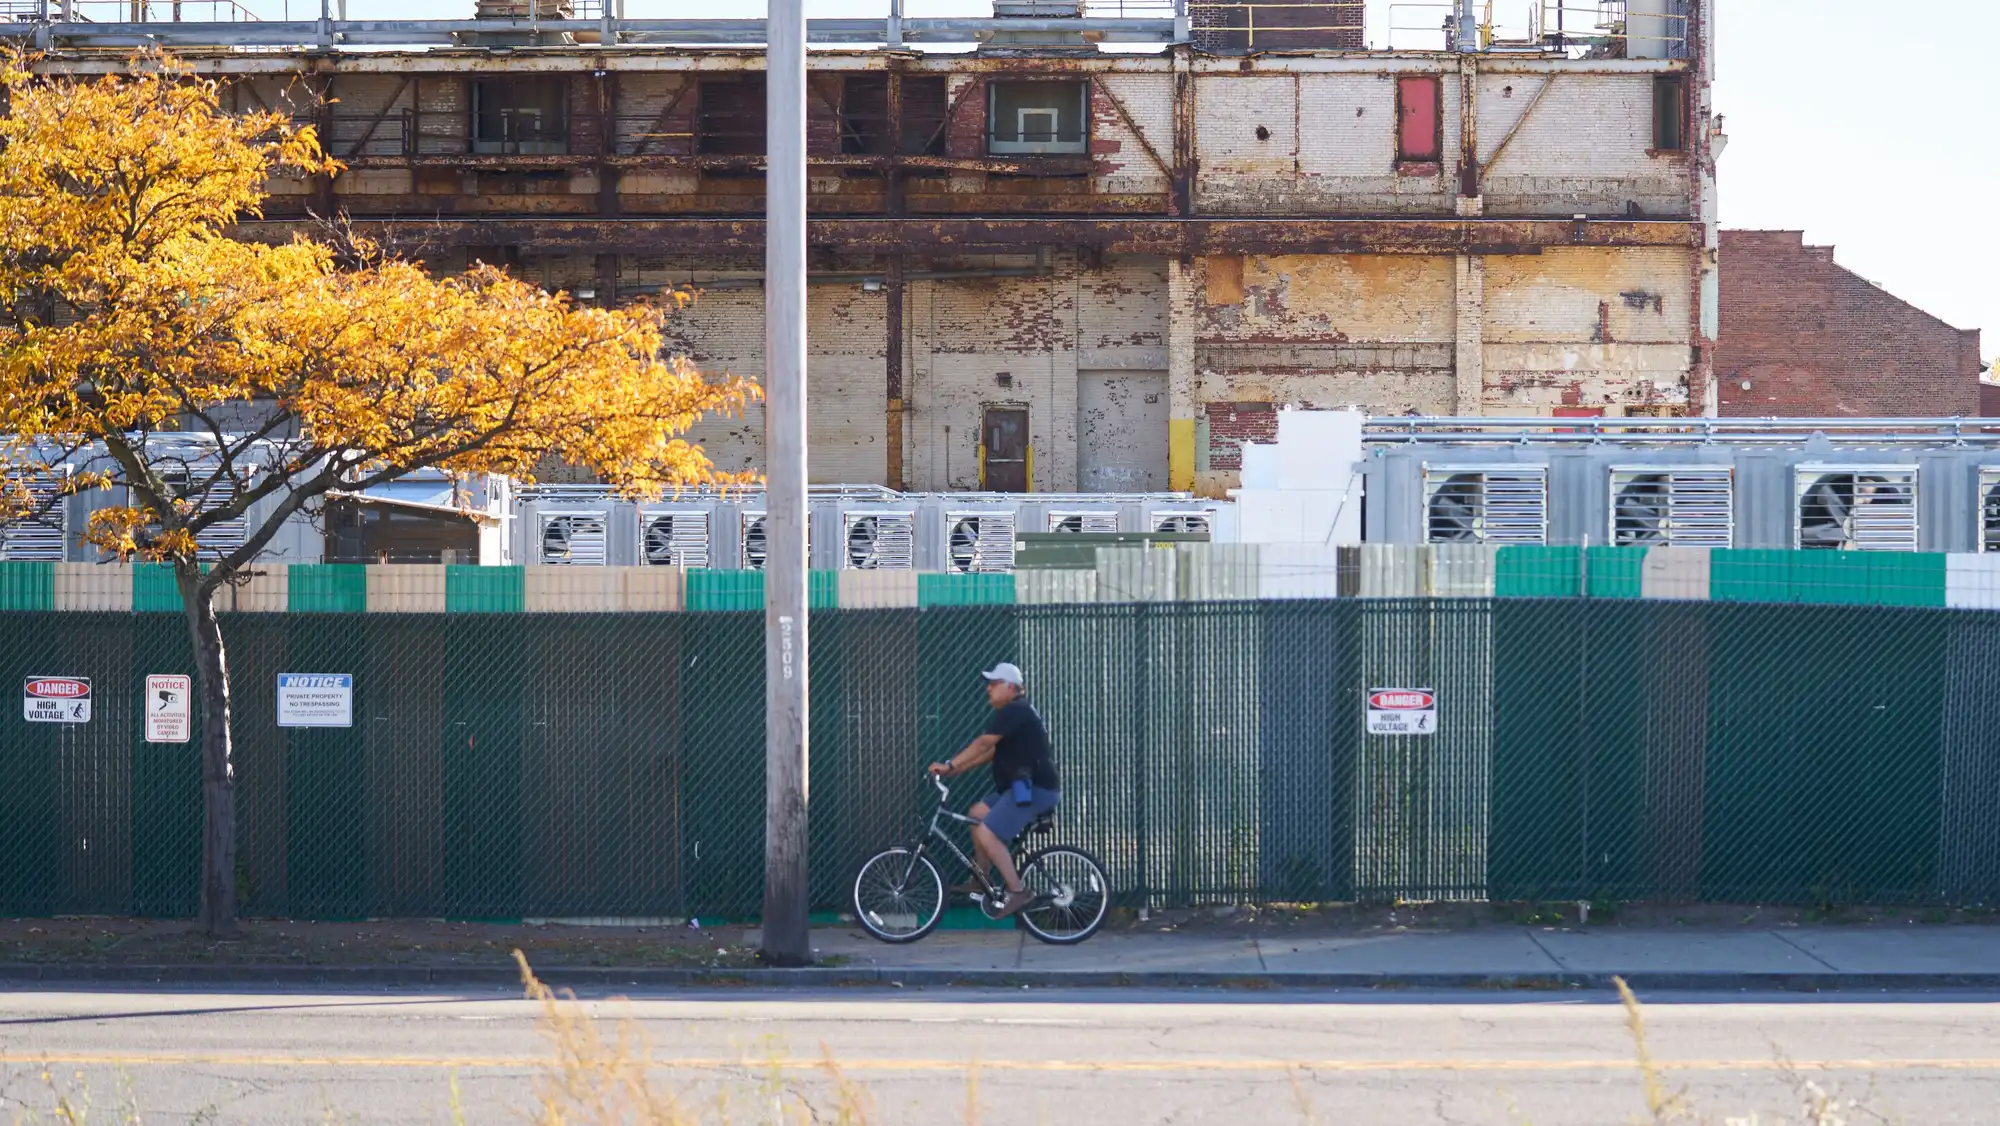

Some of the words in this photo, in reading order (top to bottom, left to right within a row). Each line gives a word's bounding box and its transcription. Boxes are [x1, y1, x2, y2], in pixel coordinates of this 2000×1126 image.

[151, 681, 185, 690] NOTICE
[285, 676, 344, 687] NOTICE
[37, 682, 79, 695] DANGER
[1380, 694, 1423, 706] DANGER
[36, 701, 57, 710] HIGH
[28, 710, 65, 720] VOLTAGE
[1380, 713, 1401, 722] HIGH
[1372, 722, 1408, 731] VOLTAGE
